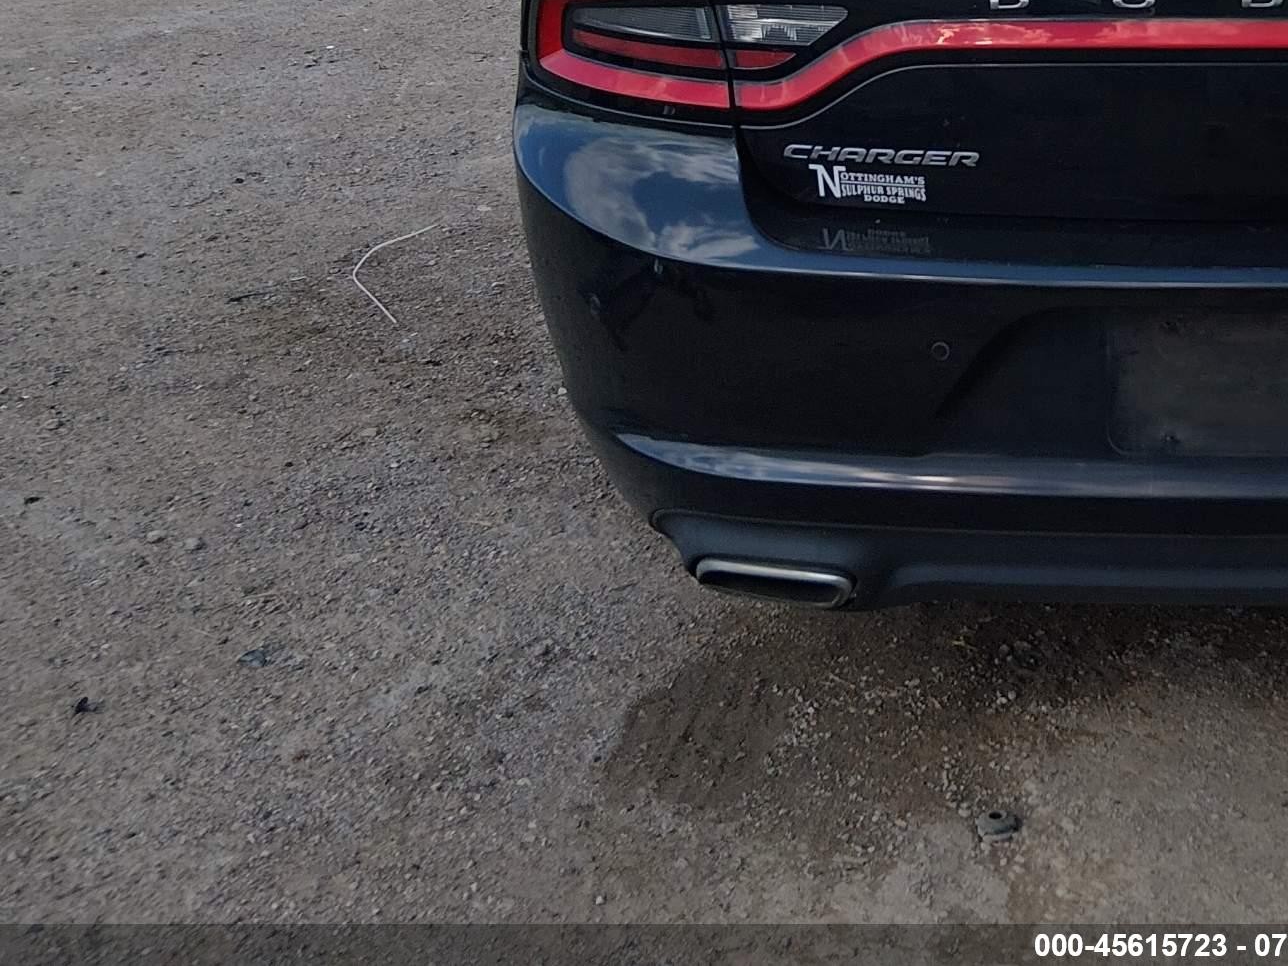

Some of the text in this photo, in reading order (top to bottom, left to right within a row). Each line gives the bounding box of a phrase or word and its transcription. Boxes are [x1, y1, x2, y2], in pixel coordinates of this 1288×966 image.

[783, 144, 980, 167] CHARGER
[808, 164, 926, 198] NOTTINGHAM'S
[841, 184, 927, 202] SULPHUR SPRINGS
[863, 194, 905, 204] DODGE
